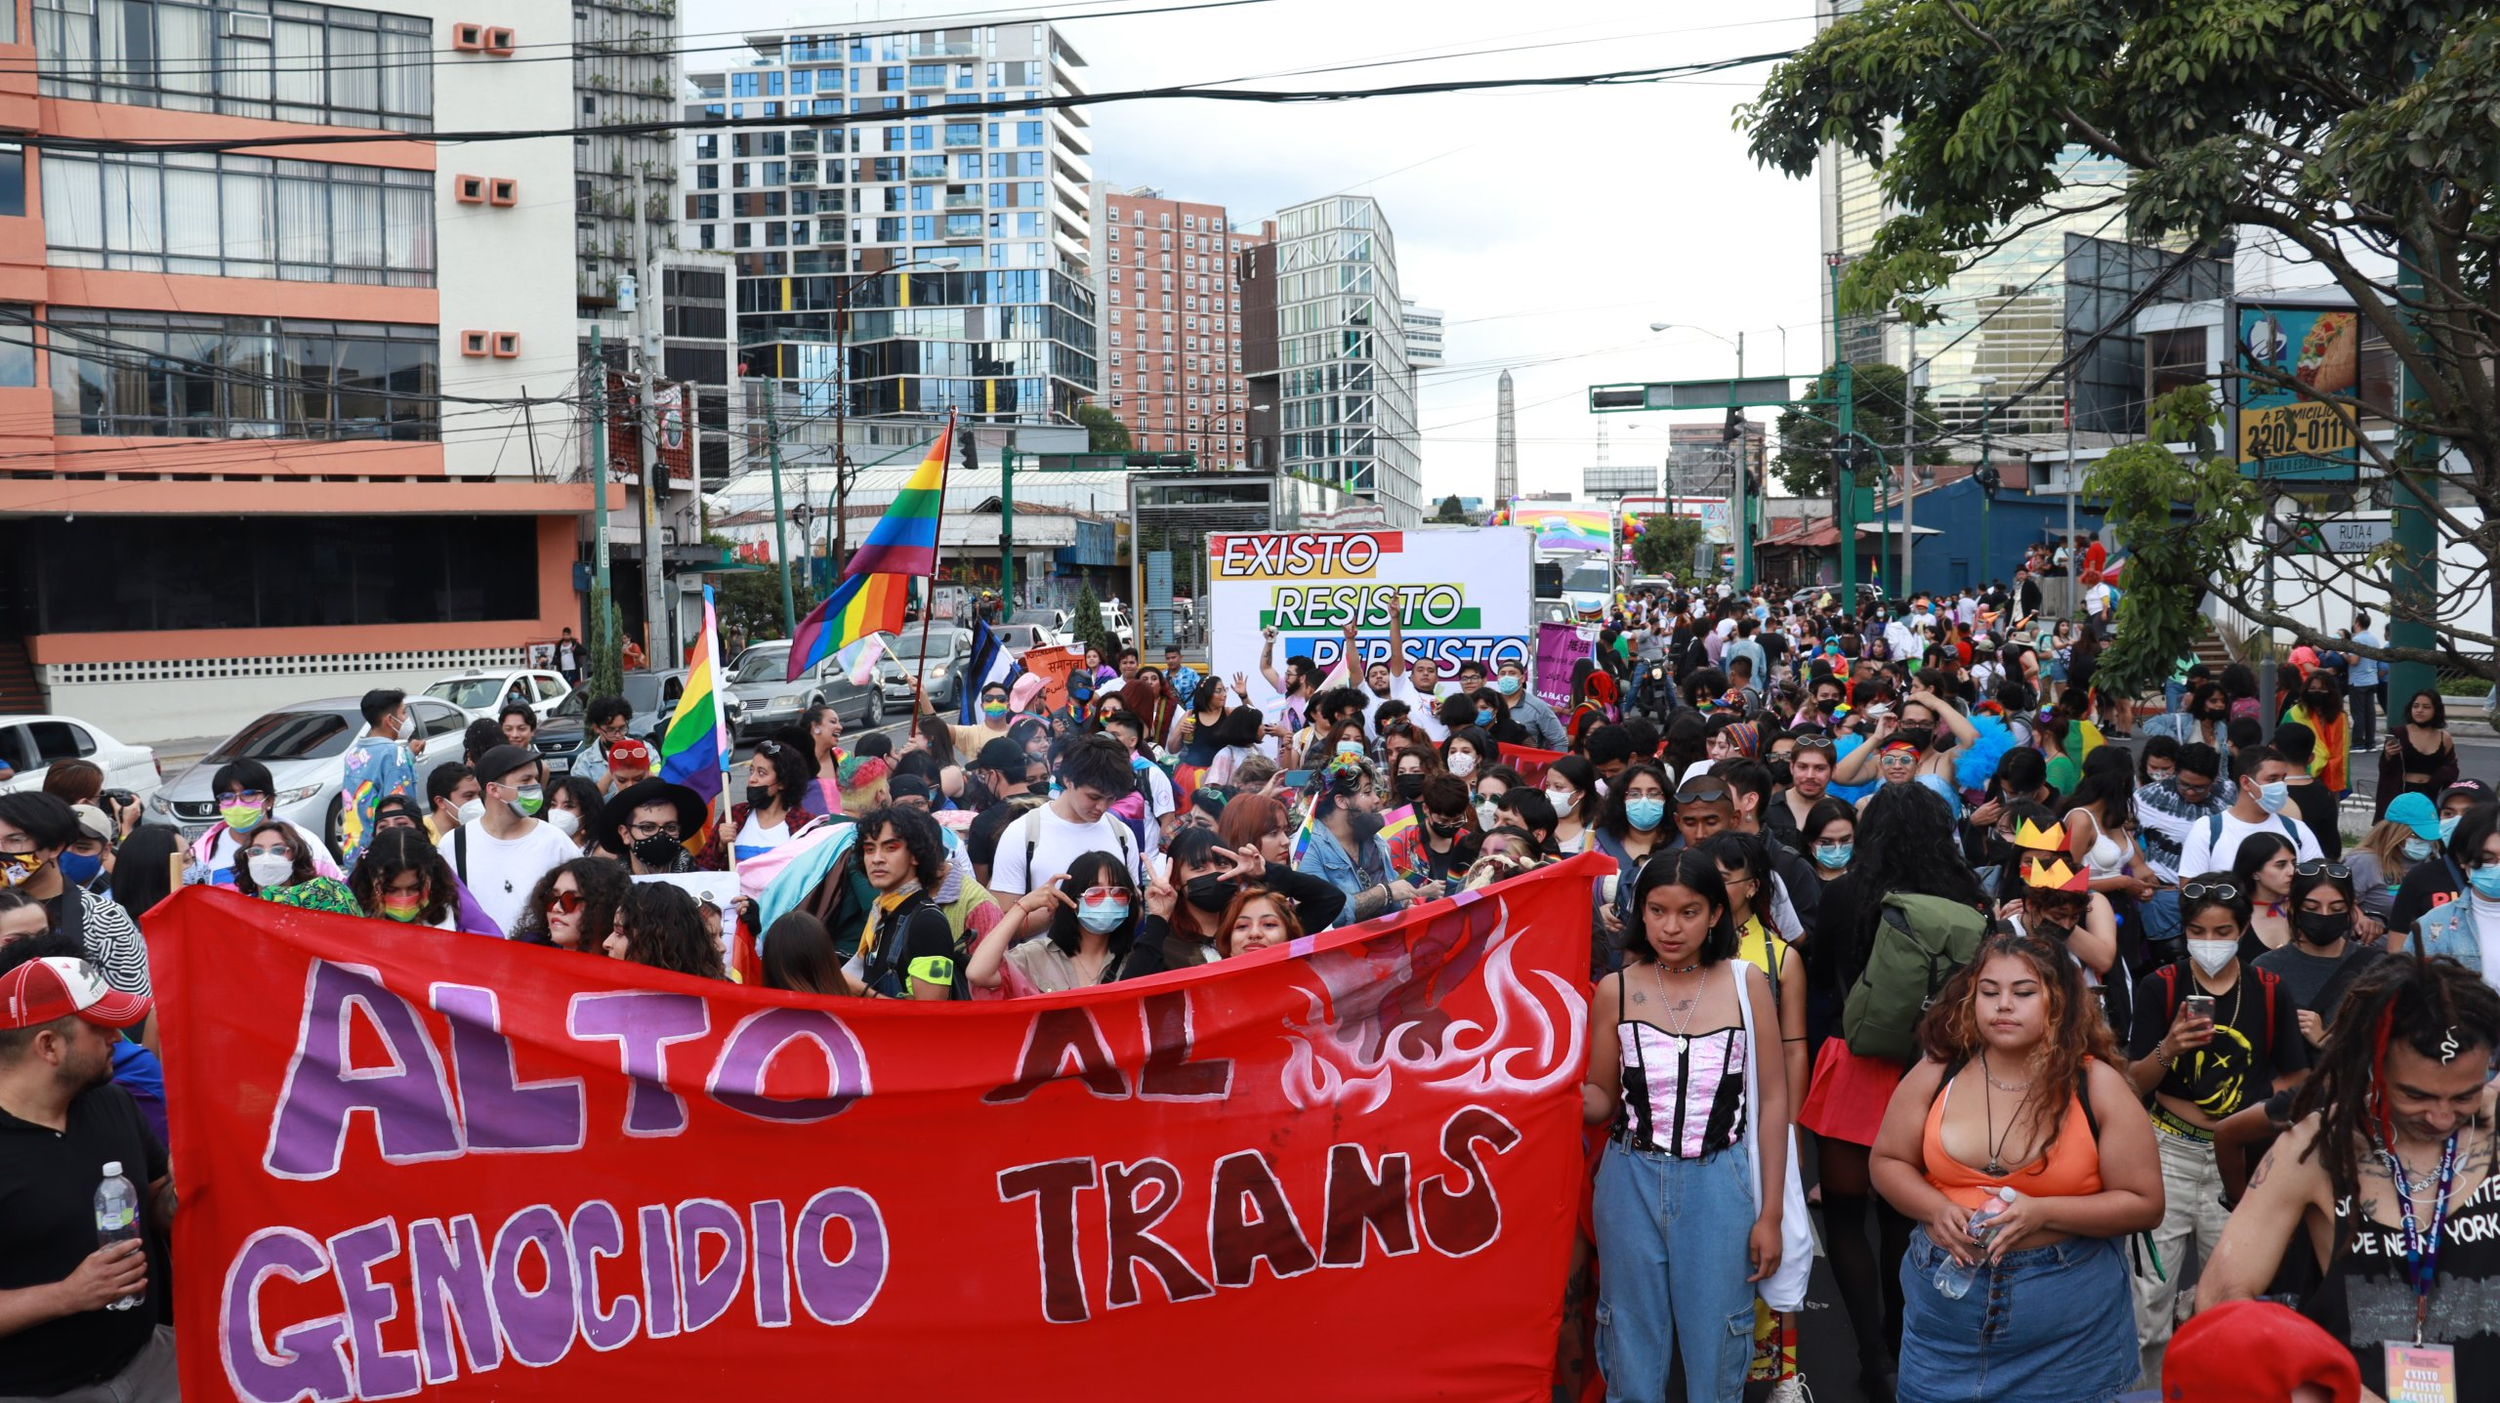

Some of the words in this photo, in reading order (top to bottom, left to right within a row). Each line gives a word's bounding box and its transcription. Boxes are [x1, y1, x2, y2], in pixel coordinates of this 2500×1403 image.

[2261, 411, 2271, 424] A
[2274, 405, 2335, 423] DMICILIO
[2340, 525, 2365, 539] RUTA
[2366, 525, 2372, 539] 4
[2340, 541, 2365, 549] ZONA
[2366, 541, 2372, 549] 4
[1221, 533, 1380, 576] EXISTO
[1273, 585, 1463, 628] RESISTO
[262, 957, 873, 1181] ALTO
[981, 988, 1236, 1104] AL
[219, 1186, 889, 1403] GENOCIDIO
[996, 1105, 1522, 1323] TRANS
[2405, 1369, 2438, 1381] EXISTO
[2403, 1380, 2441, 1392] RESISTO
[2400, 1391, 2445, 1403] PERSISTO
